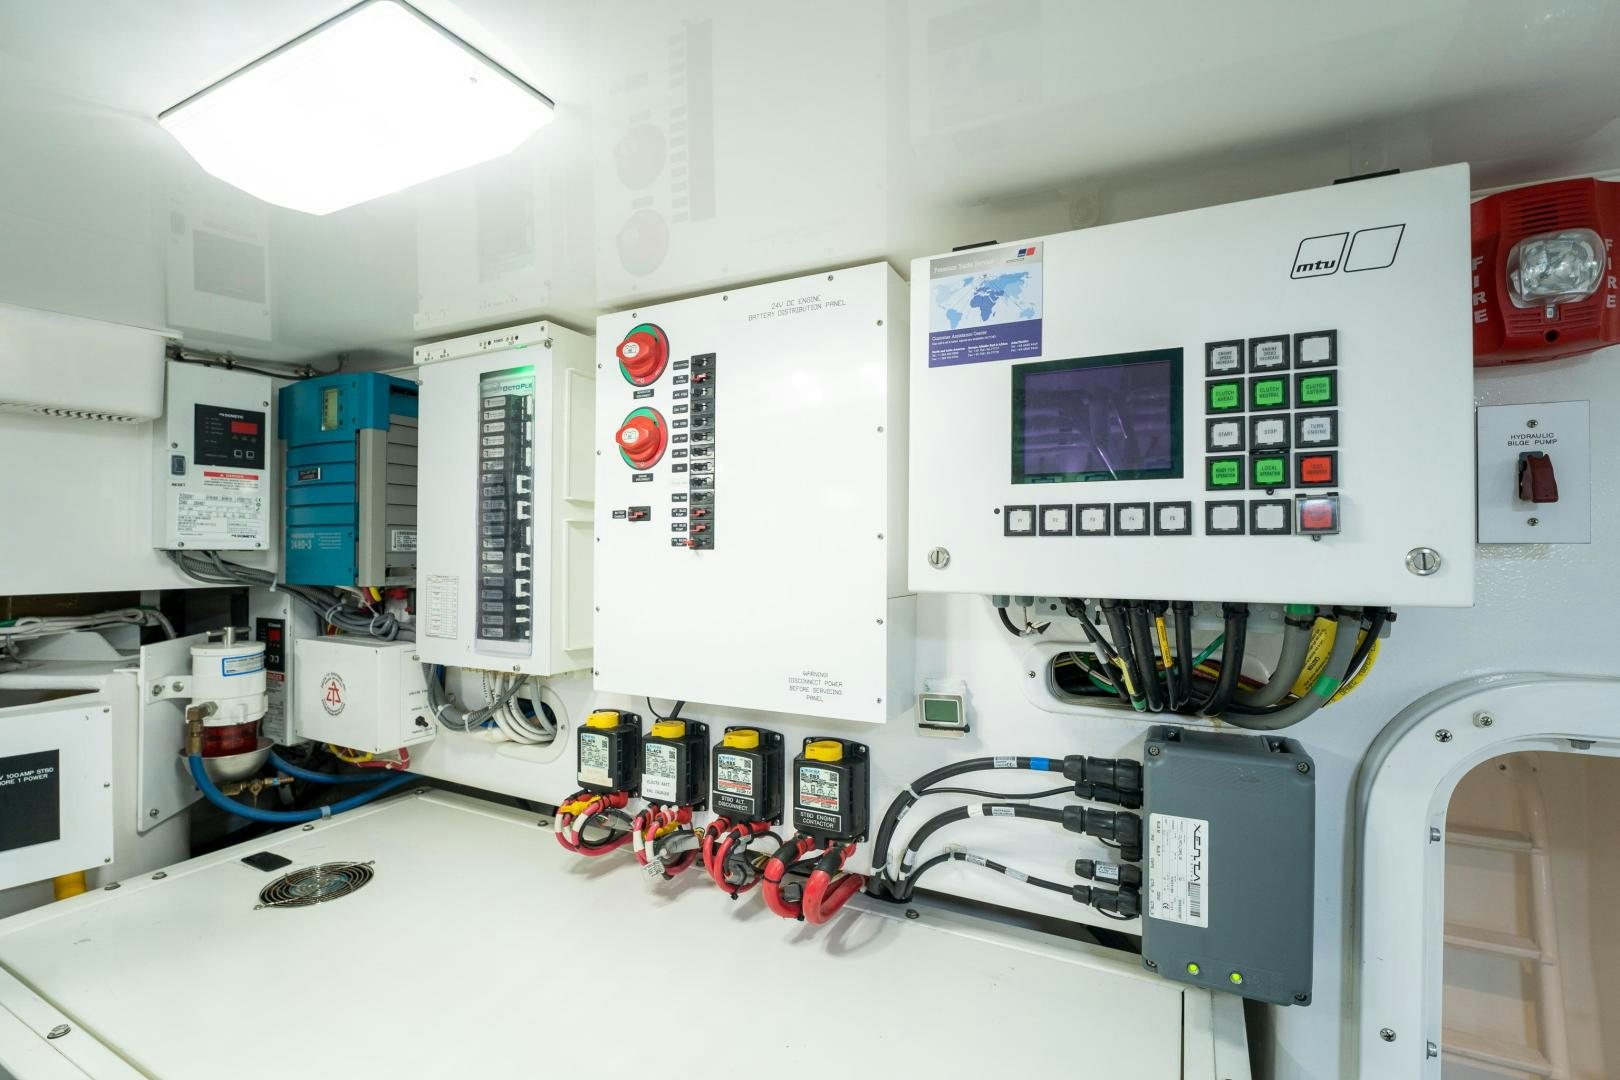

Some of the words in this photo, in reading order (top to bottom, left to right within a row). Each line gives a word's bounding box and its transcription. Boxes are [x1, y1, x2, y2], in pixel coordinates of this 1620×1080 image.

[1296, 260, 1336, 272] mtu
[1604, 238, 1617, 308] FIRE
[1472, 255, 1488, 324] FIRE
[772, 301, 784, 310] 24V
[798, 294, 822, 305] ENGINE
[748, 311, 776, 322] BATTERY
[777, 304, 822, 317] DISTRIBUTION
[825, 299, 846, 309] PANEL
[788, 677, 821, 686] DISCONNECT
[812, 687, 842, 696] SERVICING
[23, 773, 48, 782] POWER
[721, 795, 734, 804] STBD
[718, 801, 748, 811] DISCONNECT
[800, 811, 814, 819] STBD
[816, 814, 837, 824] ENGINE
[802, 817, 834, 829] CONTACTOR
[1193, 824, 1201, 882] XENTA
